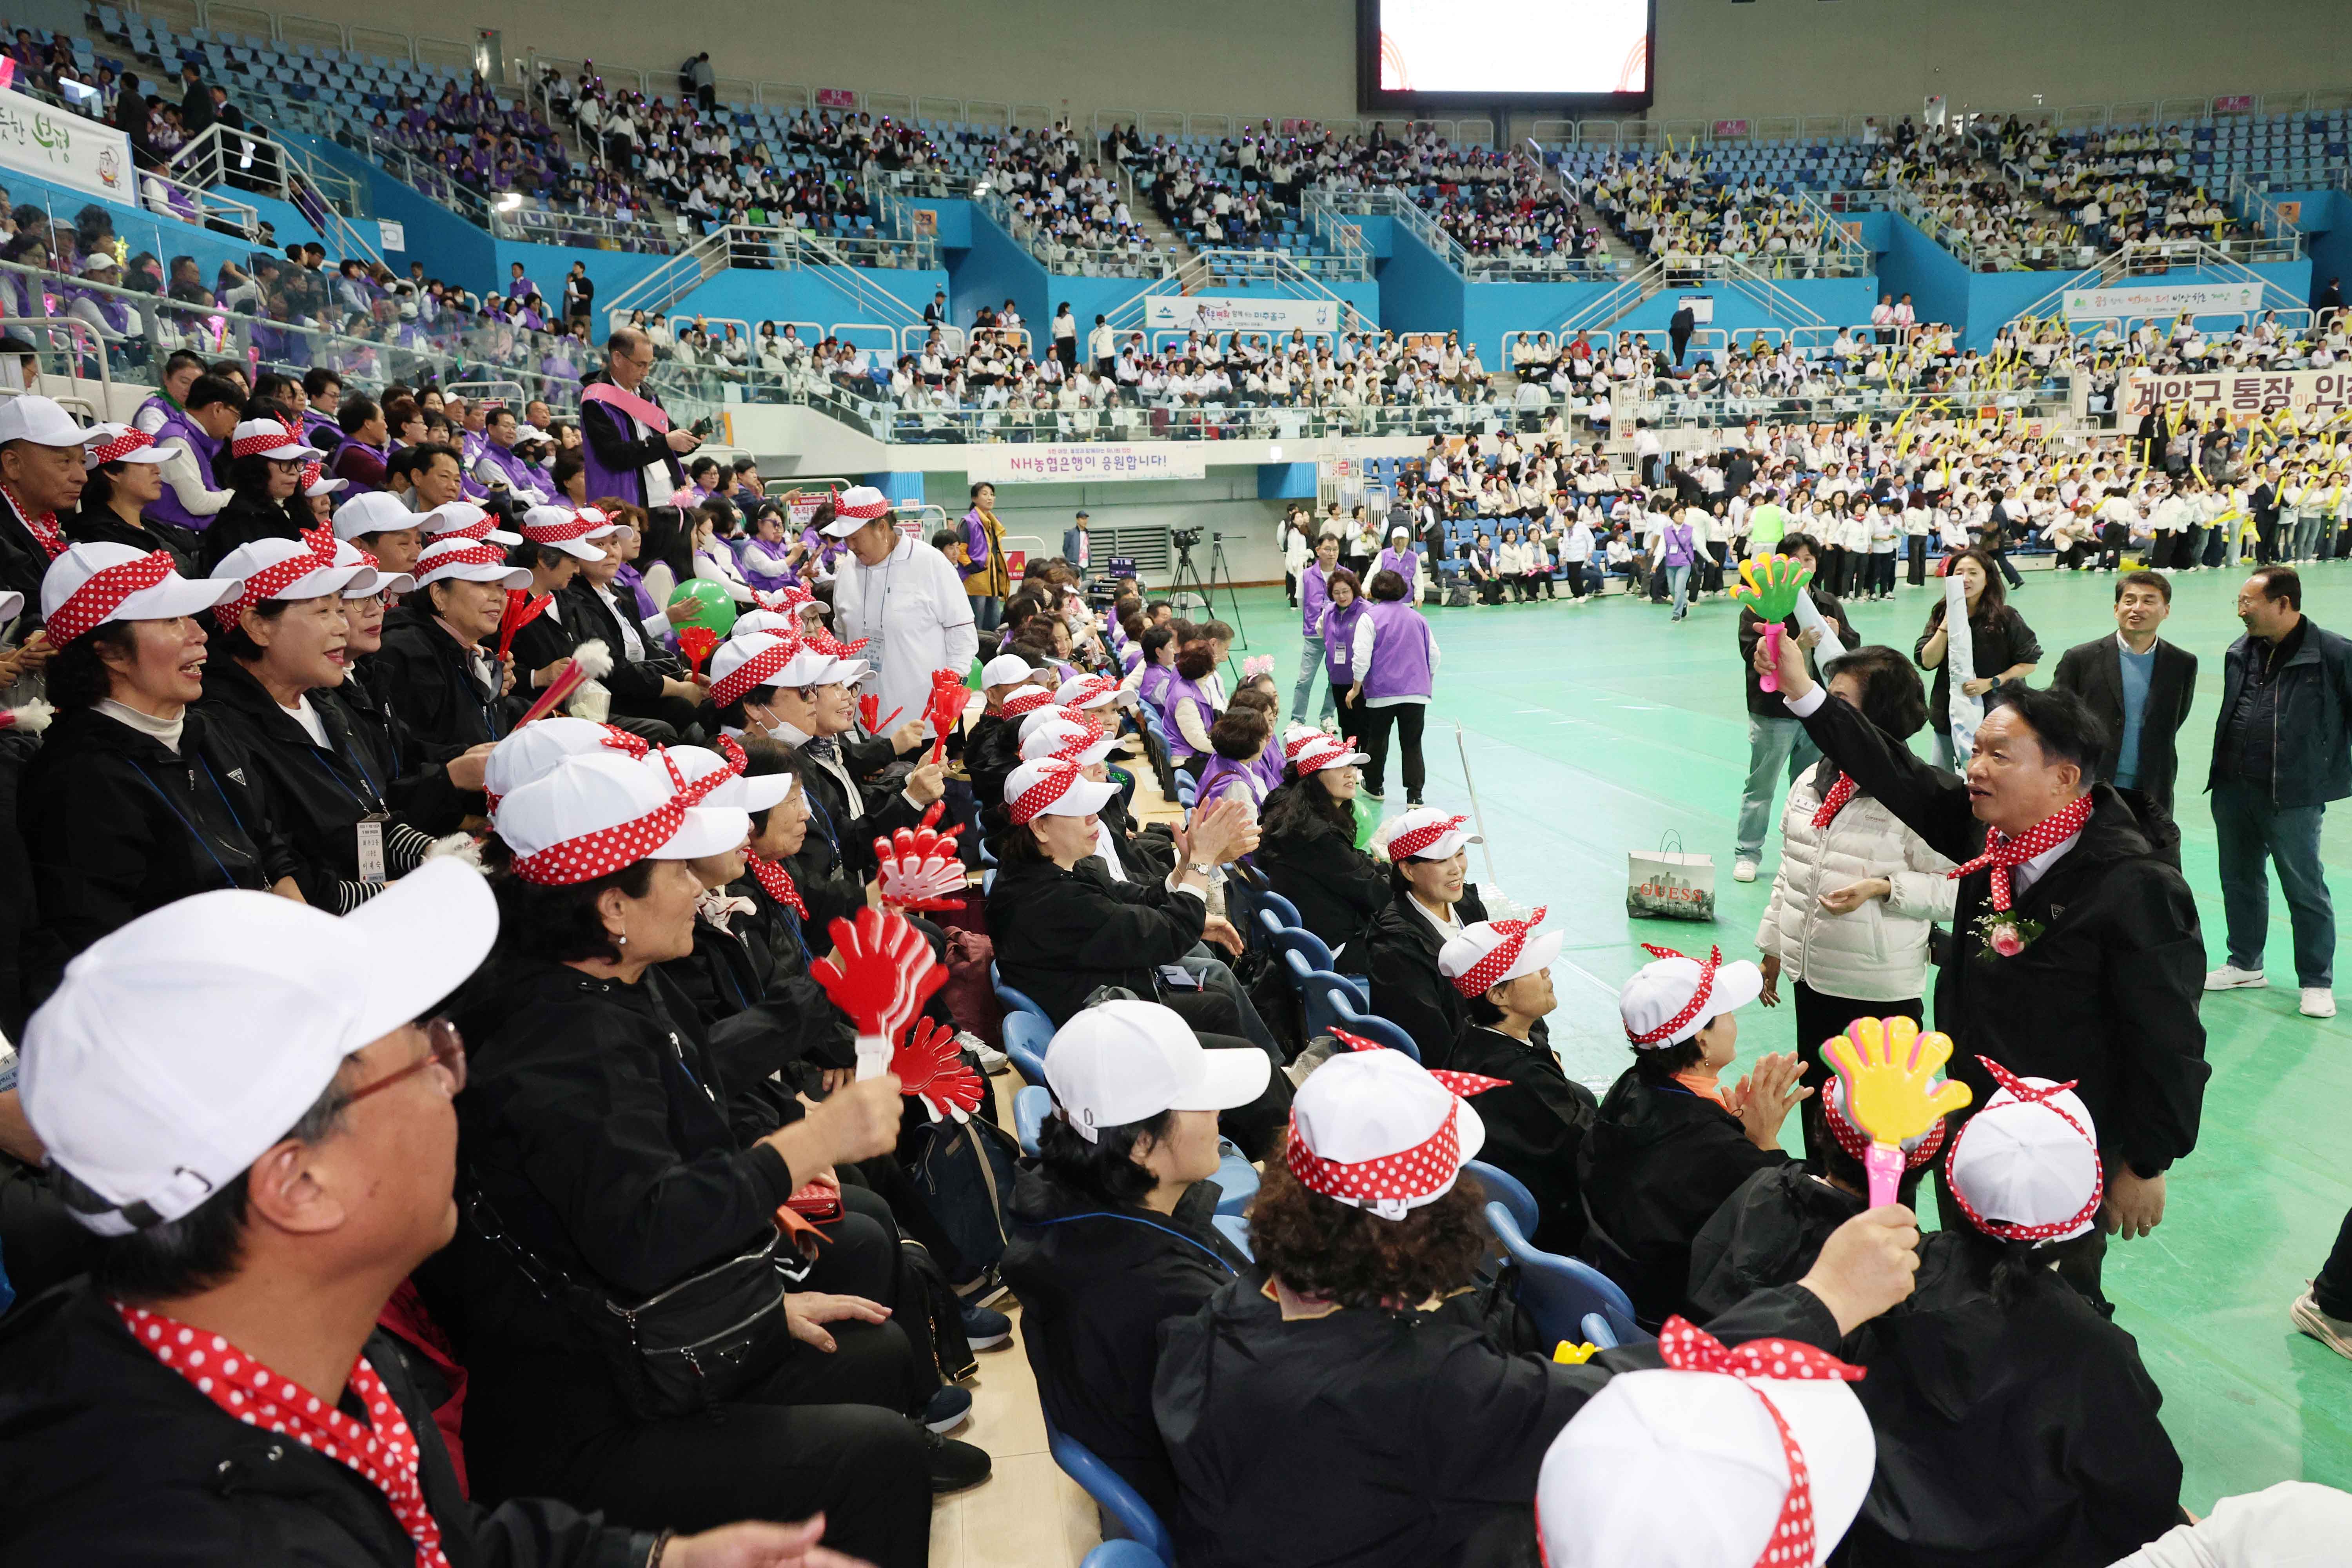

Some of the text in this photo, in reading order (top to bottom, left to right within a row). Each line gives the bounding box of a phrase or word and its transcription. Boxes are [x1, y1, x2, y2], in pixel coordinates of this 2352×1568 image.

[31, 113, 70, 163] 부평
[1254, 312, 1286, 321] 미추홀구
[2134, 379, 2221, 413] 계양구
[2315, 374, 2352, 406] 인
[1011, 455, 1166, 472] NH농협은행이 응원합니다!
[1640, 883, 1703, 902] GUESS
